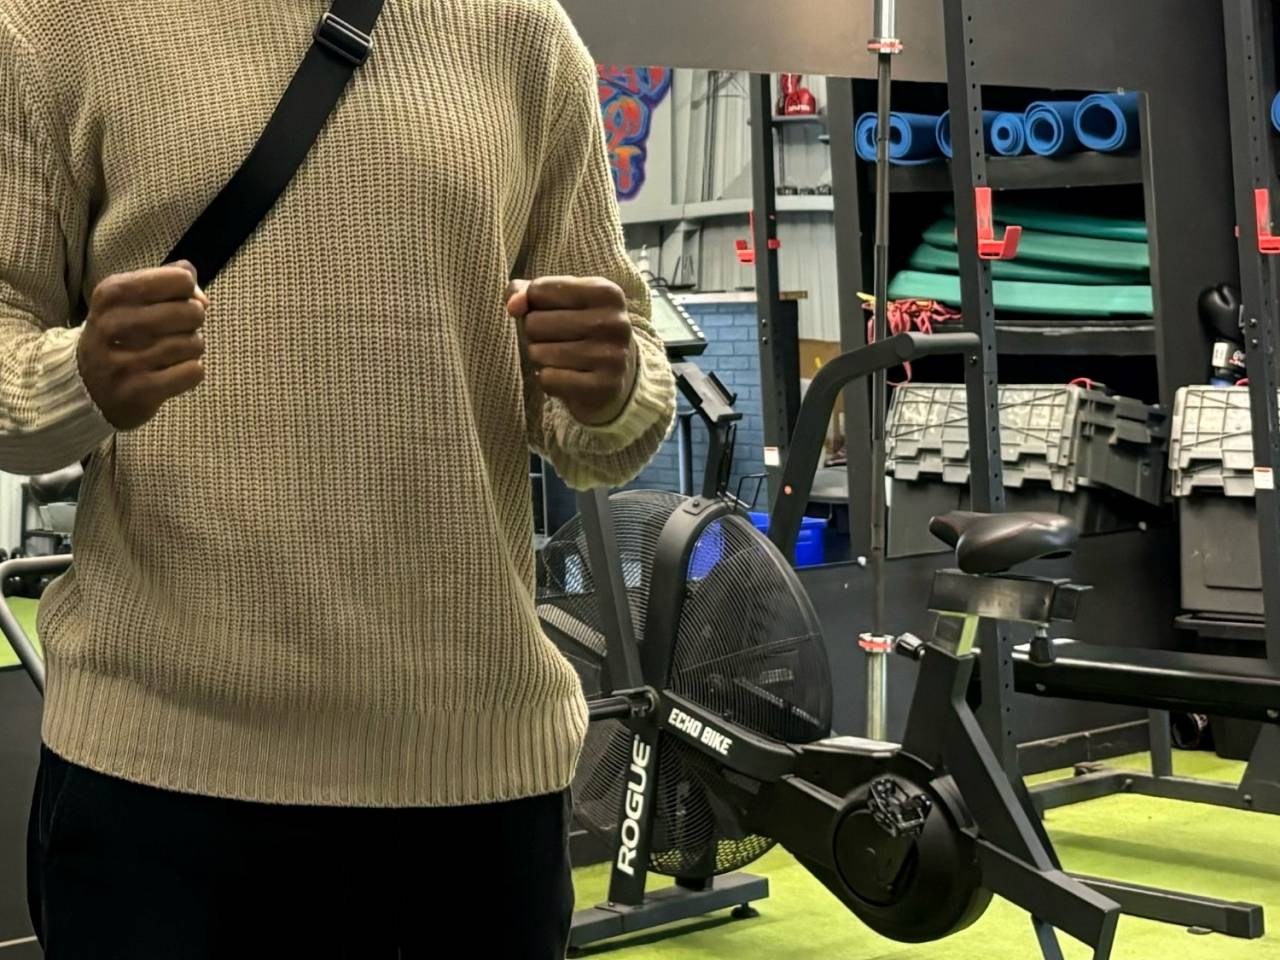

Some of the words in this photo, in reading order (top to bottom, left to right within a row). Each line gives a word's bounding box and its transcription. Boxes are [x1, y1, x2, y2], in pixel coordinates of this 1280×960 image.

[668, 707, 703, 739] ECHO
[700, 726, 734, 756] BIKE
[617, 733, 652, 877] ROGUE
